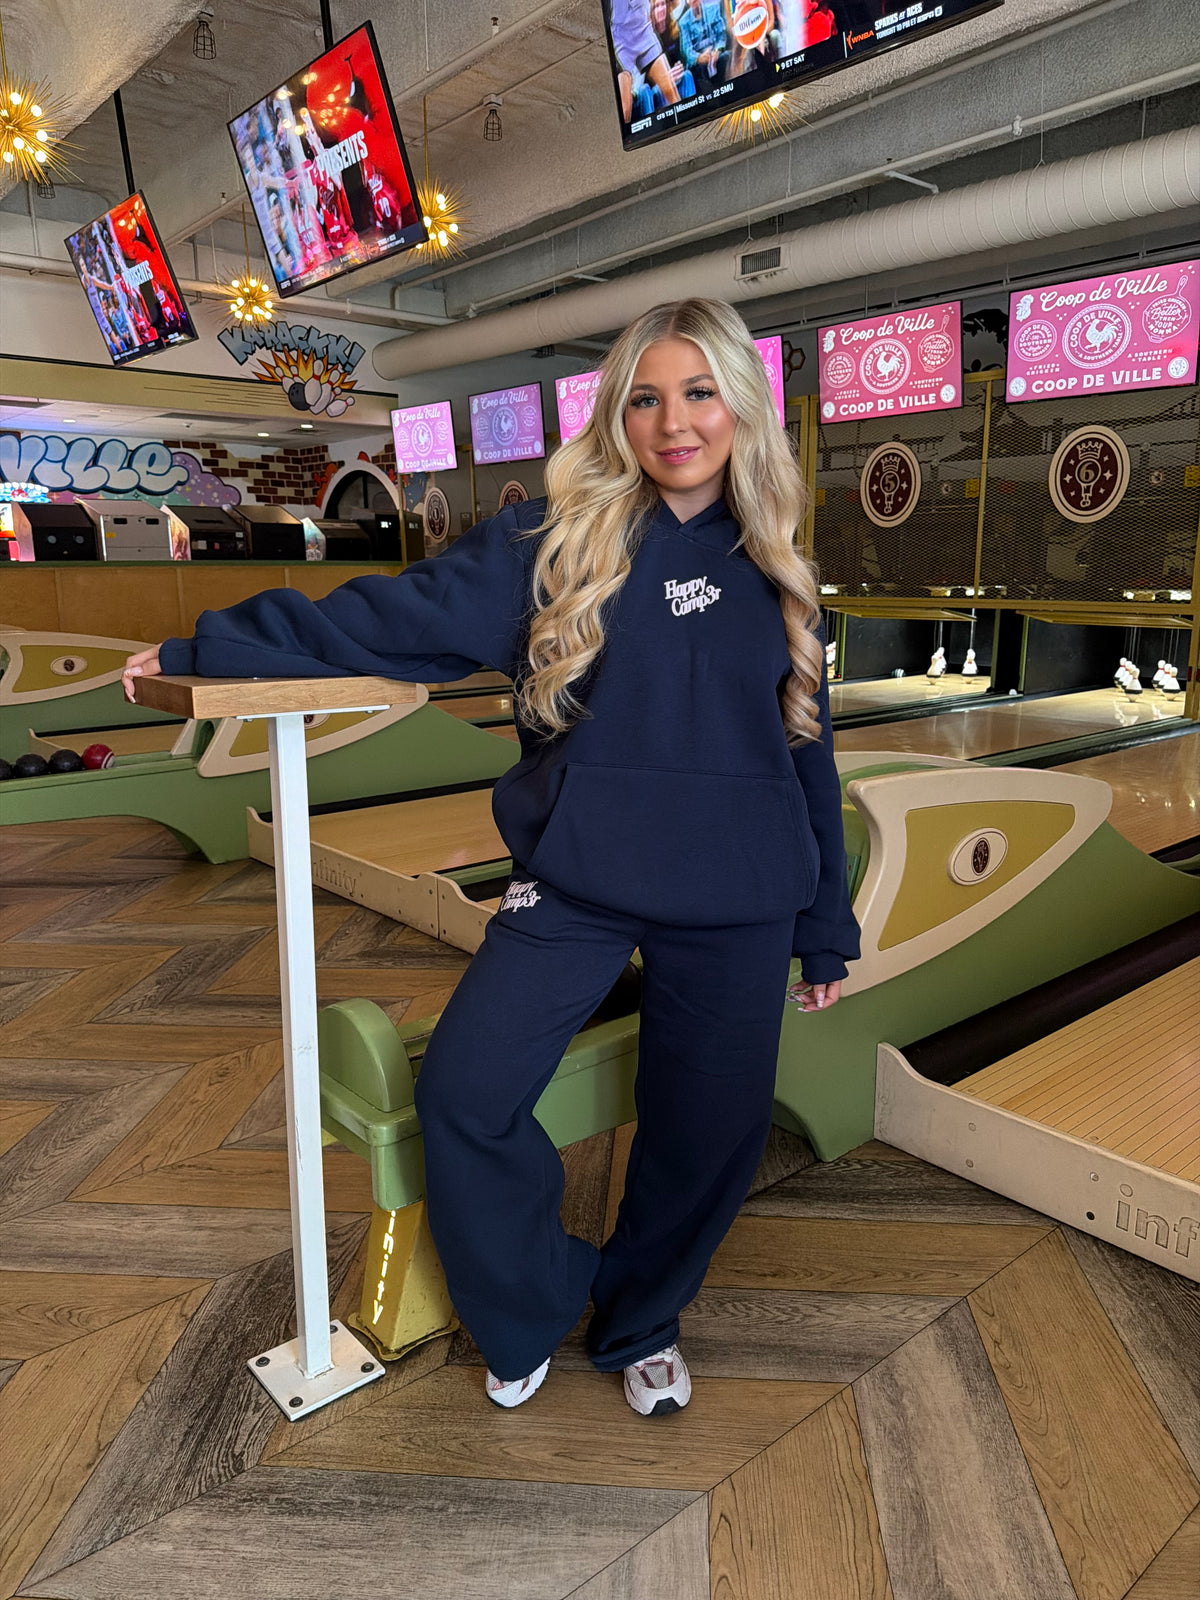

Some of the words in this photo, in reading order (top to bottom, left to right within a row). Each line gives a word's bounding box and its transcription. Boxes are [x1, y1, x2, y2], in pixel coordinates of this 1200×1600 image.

[874, 12, 898, 31] SPARKS
[906, 2, 923, 18] ACES
[851, 29, 874, 44] WNBA
[780, 62, 785, 70] 9
[785, 58, 794, 68] ET
[794, 53, 806, 64] SAT
[676, 97, 698, 113] Missouri
[698, 95, 705, 104] St
[713, 89, 720, 98] 22
[720, 83, 734, 95] SMU
[631, 116, 653, 134] ESPN
[1039, 291, 1086, 312] Coop
[1089, 281, 1112, 302] de
[1115, 273, 1168, 298] Ville
[1150, 303, 1183, 321] Better
[840, 327, 875, 345] Coop
[877, 319, 894, 337] de
[895, 313, 935, 335] Ville
[1070, 321, 1082, 348] COOP
[1082, 311, 1096, 323] DE
[1097, 310, 1121, 325] VILLE
[865, 353, 874, 376] COOP
[884, 344, 903, 357] VILLE
[568, 380, 591, 394] Coop
[1031, 376, 1078, 394] COOP
[1083, 373, 1105, 389] DE
[1111, 367, 1162, 385] VILLE
[480, 396, 498, 410] Coop
[508, 390, 529, 405] Ville
[839, 401, 874, 416] COOP
[877, 399, 894, 412] DE
[898, 393, 936, 408] VILLE
[483, 450, 501, 460] COOP
[503, 449, 512, 457] DE
[513, 446, 533, 456] VILLE
[884, 474, 896, 491] 5
[1079, 462, 1095, 482] 6
[664, 575, 708, 602] Happy
[671, 584, 722, 617] Camp3r
[1116, 1183, 1200, 1259] inf
